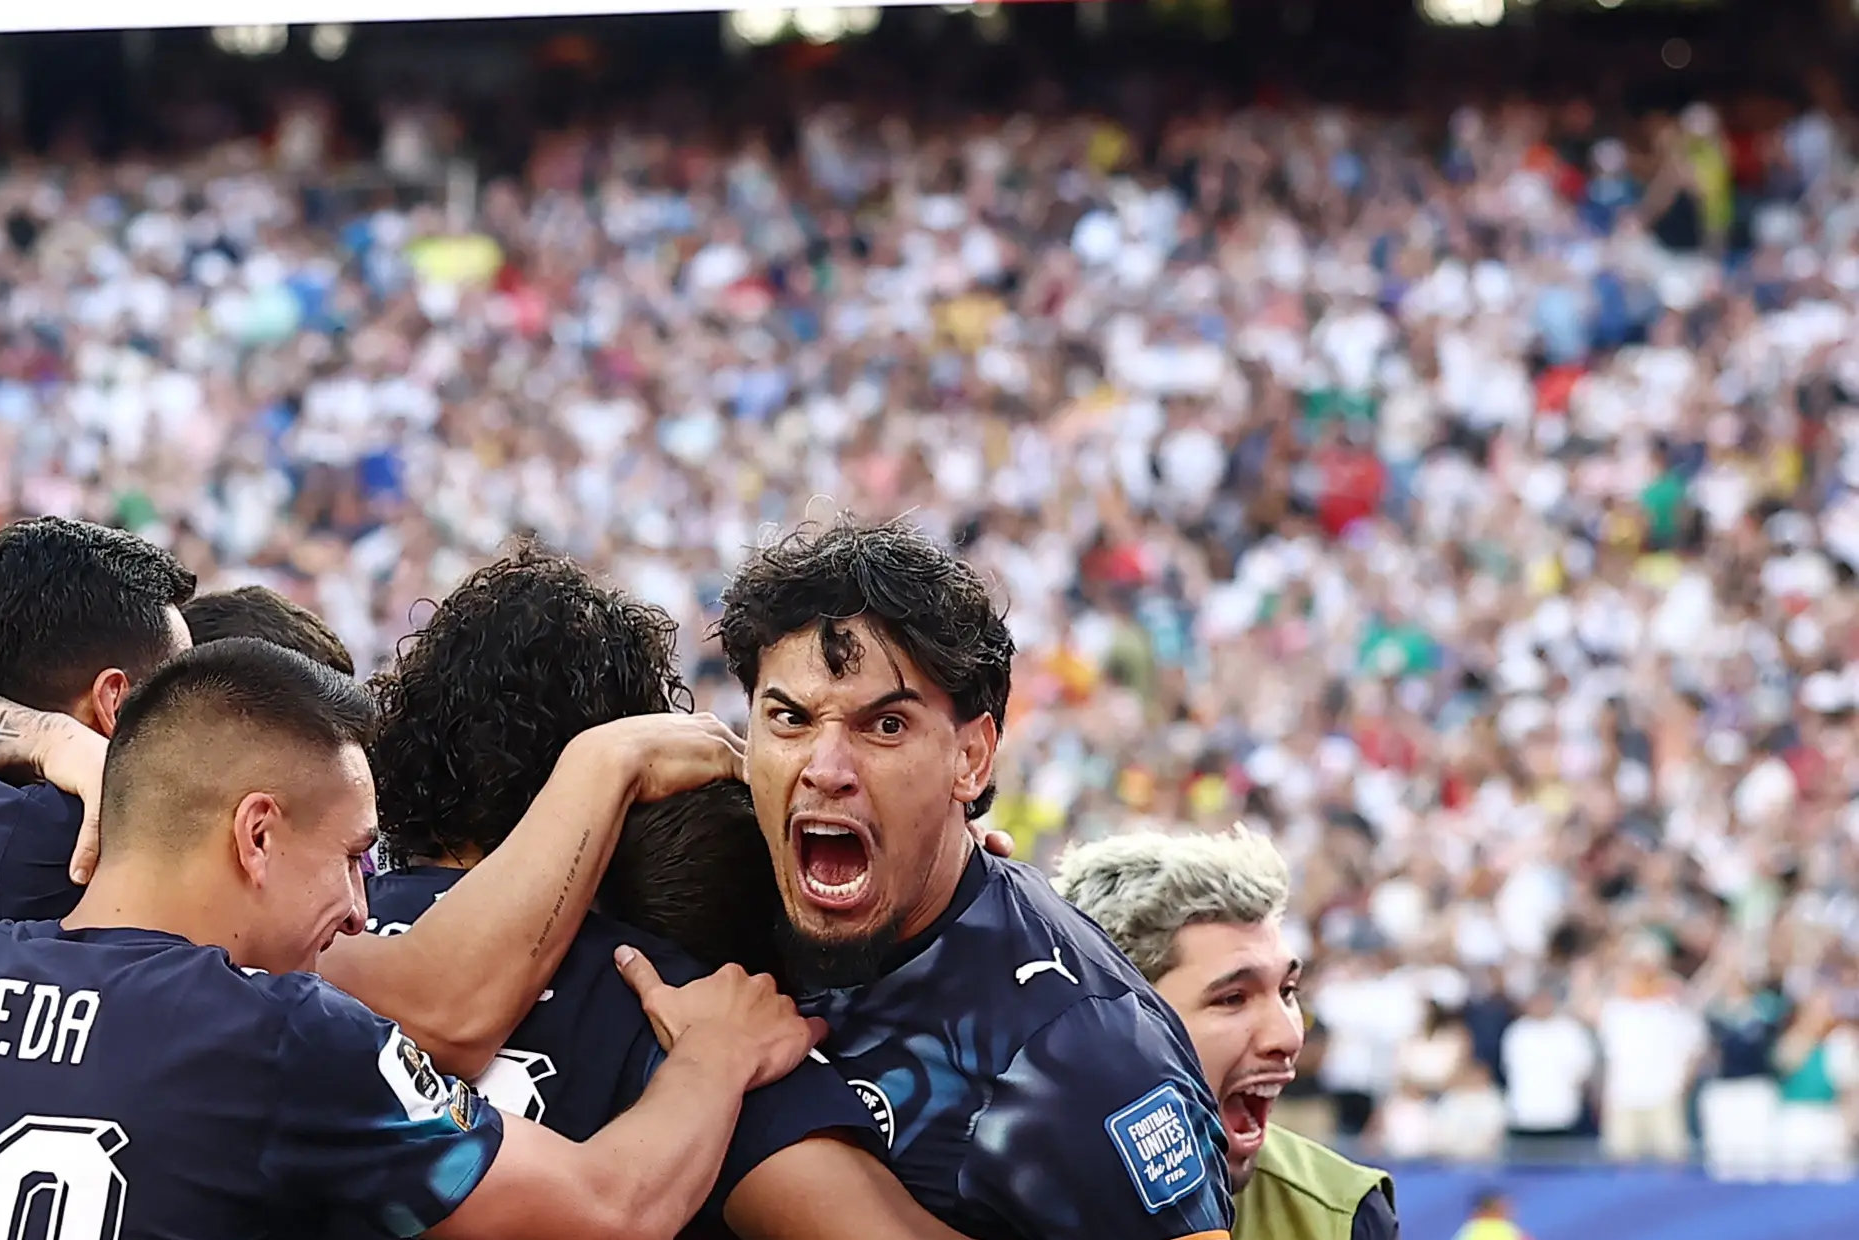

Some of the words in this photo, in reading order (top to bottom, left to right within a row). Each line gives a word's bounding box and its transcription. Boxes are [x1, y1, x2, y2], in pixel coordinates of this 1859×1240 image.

[1127, 1103, 1177, 1142] FOOTBALL
[1135, 1118, 1186, 1161] UNITES
[1143, 1162, 1165, 1182] the
[1163, 1137, 1194, 1171] World
[1165, 1168, 1187, 1185] FIFA
